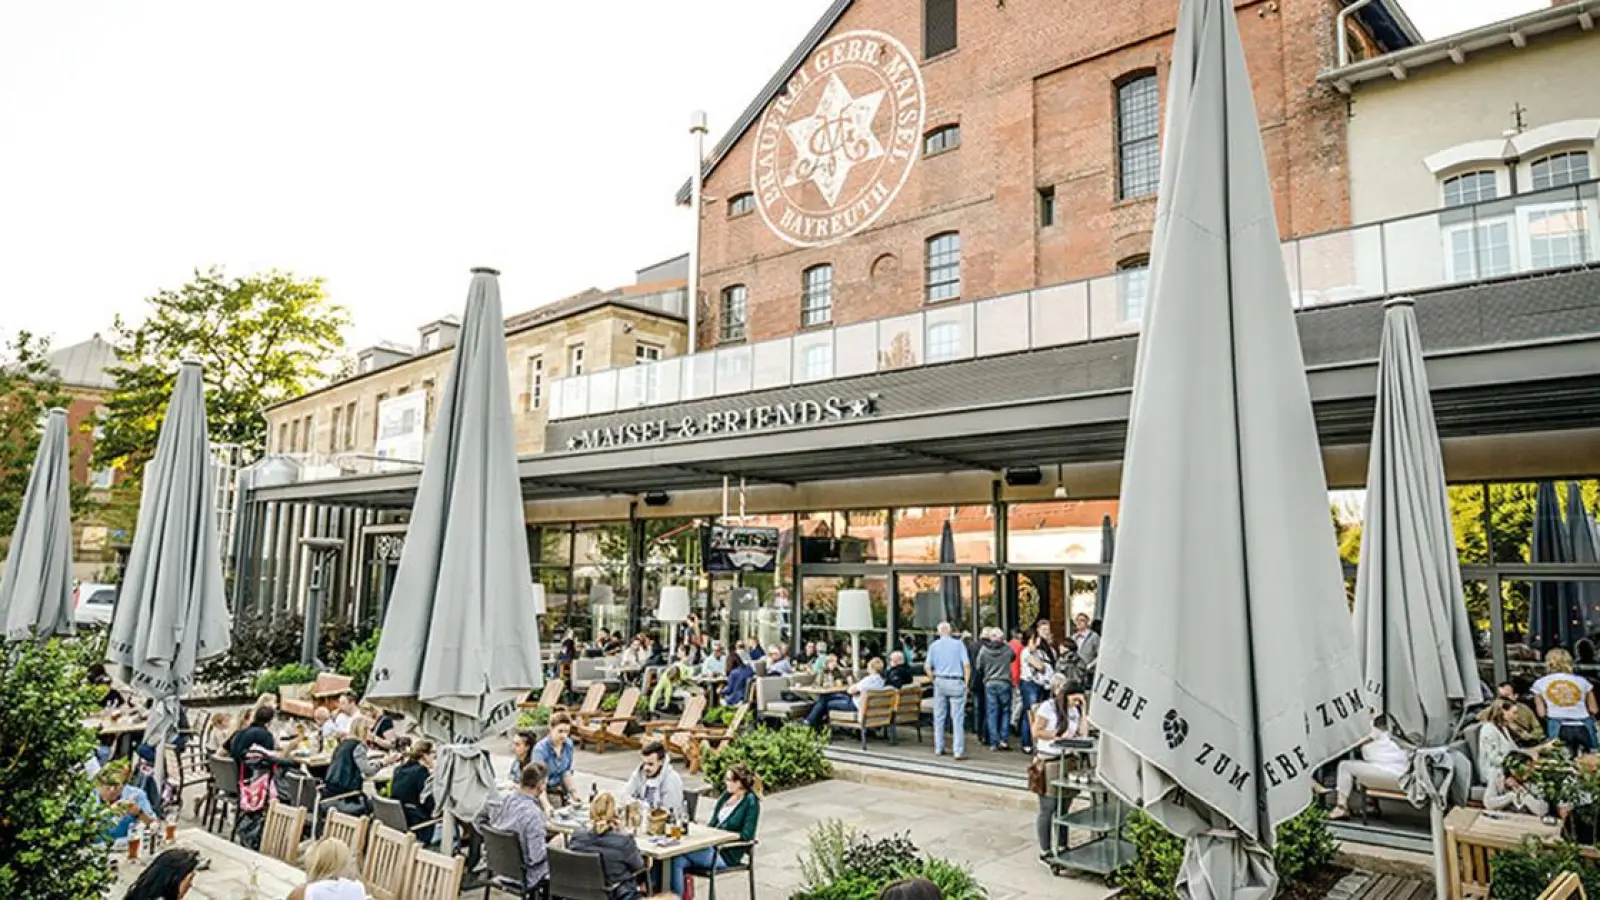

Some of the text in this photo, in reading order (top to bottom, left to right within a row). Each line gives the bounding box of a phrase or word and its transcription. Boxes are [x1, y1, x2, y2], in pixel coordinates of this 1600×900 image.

[758, 68, 812, 209] BRAUEREI
[882, 53, 919, 164] MAISEL
[779, 179, 890, 238] BAYREUTH
[677, 415, 697, 438] &
[706, 395, 842, 435] FRIENDS
[1315, 688, 1364, 728] ZUM
[1194, 742, 1251, 792] ZUM
